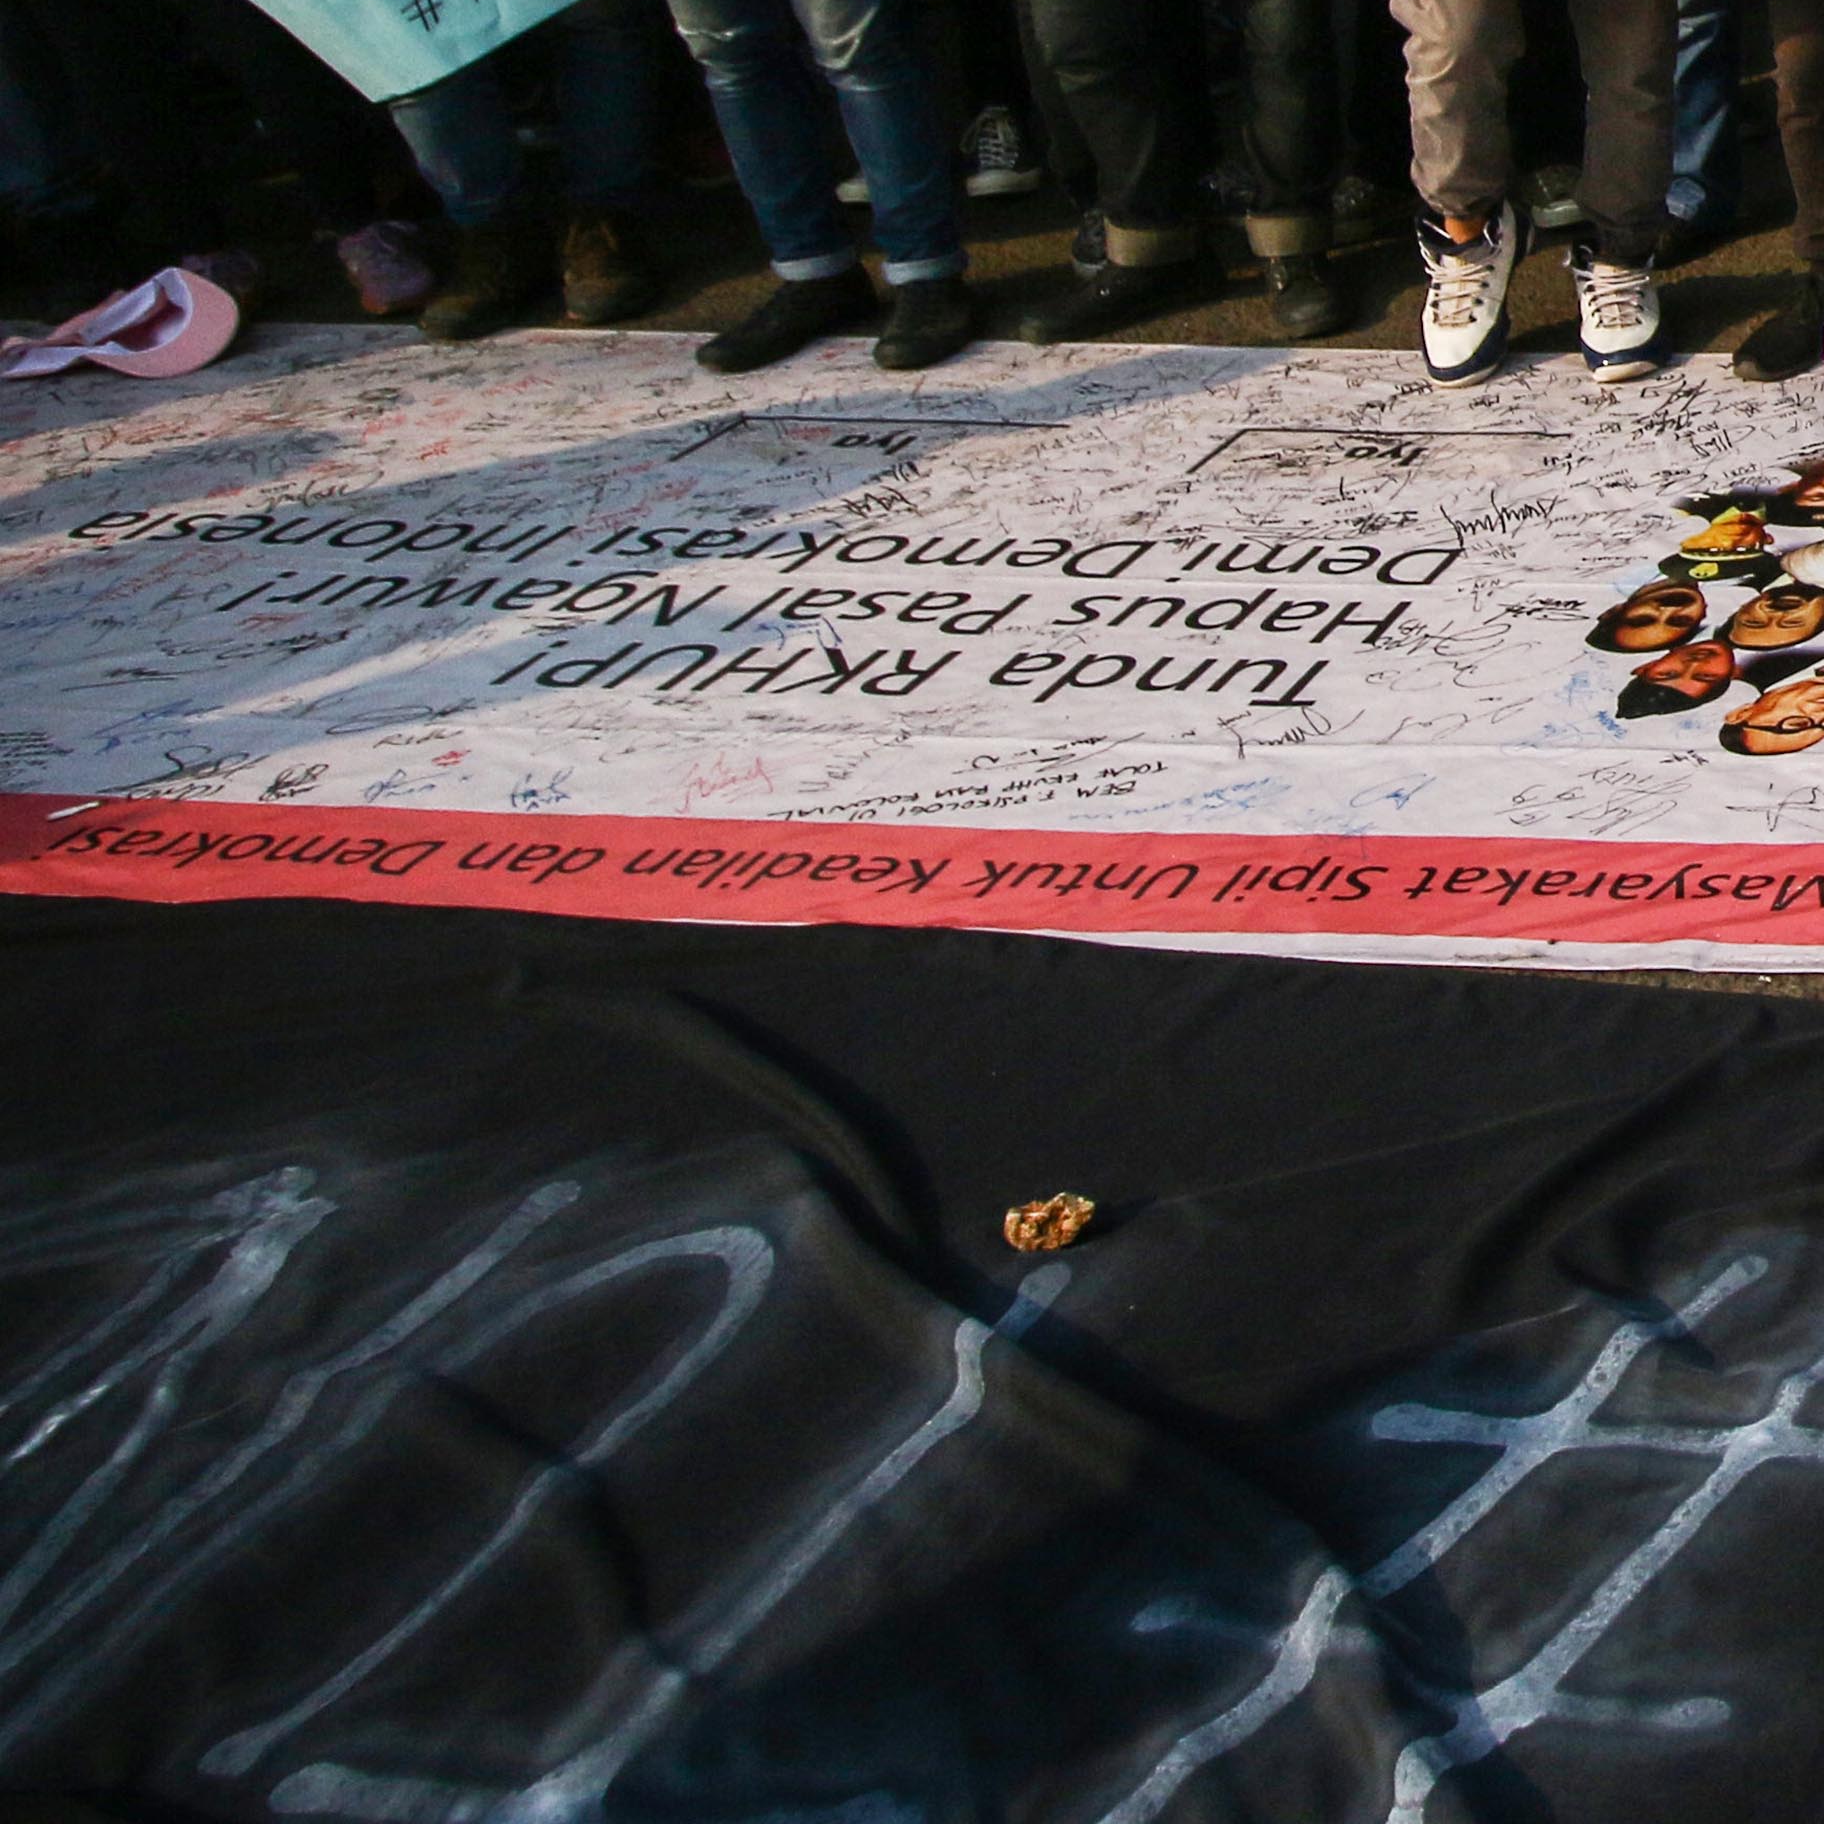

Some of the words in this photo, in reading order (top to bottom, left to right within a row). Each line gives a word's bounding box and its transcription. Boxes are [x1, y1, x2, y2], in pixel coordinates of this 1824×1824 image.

[68, 509, 578, 565] Indonesia
[572, 526, 1156, 580] Demokrasi
[1166, 539, 1462, 587] Demi
[217, 571, 730, 630] Ngawur!
[723, 583, 1033, 638] Pasal
[1053, 587, 1412, 648] Hapus
[490, 639, 962, 697] RKHUP!
[989, 651, 1330, 707] Tunda
[46, 819, 447, 876] Demokrasi
[457, 832, 600, 886] dan
[630, 840, 950, 896] Keadilan
[968, 859, 1200, 902] Untuk
[1222, 849, 1391, 906] Sipil
